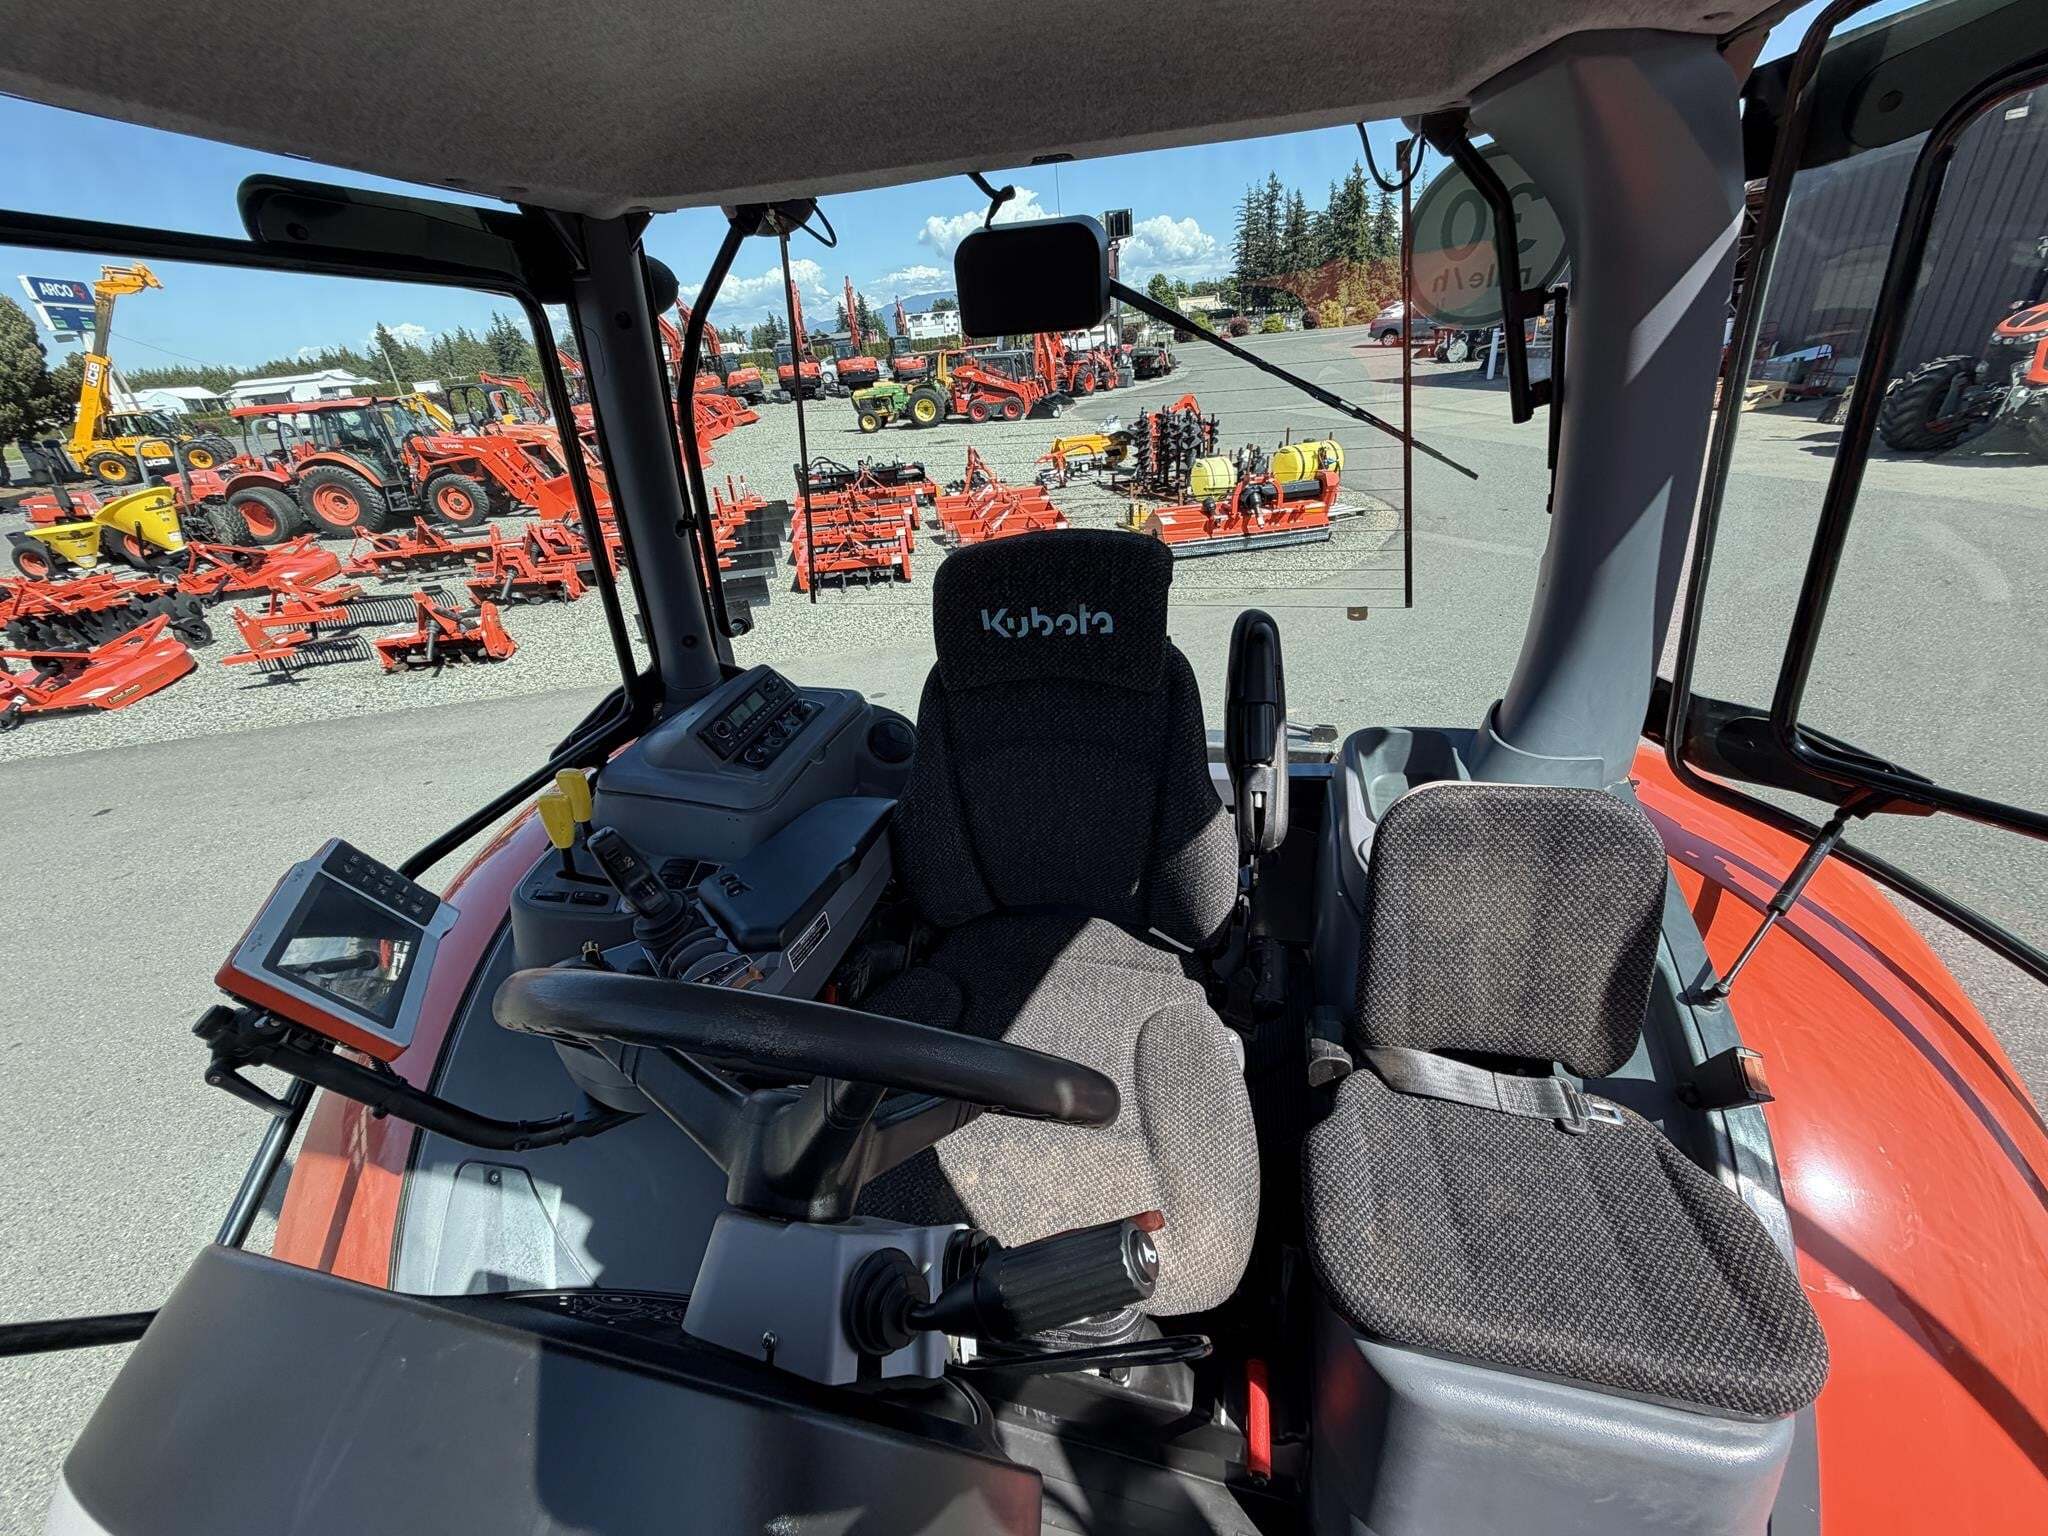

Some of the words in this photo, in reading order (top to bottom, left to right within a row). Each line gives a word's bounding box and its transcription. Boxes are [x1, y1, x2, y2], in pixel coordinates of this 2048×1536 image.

[38, 281, 74, 298] ARCO
[86, 361, 100, 388] JCB
[980, 603, 1114, 638] Kubota
